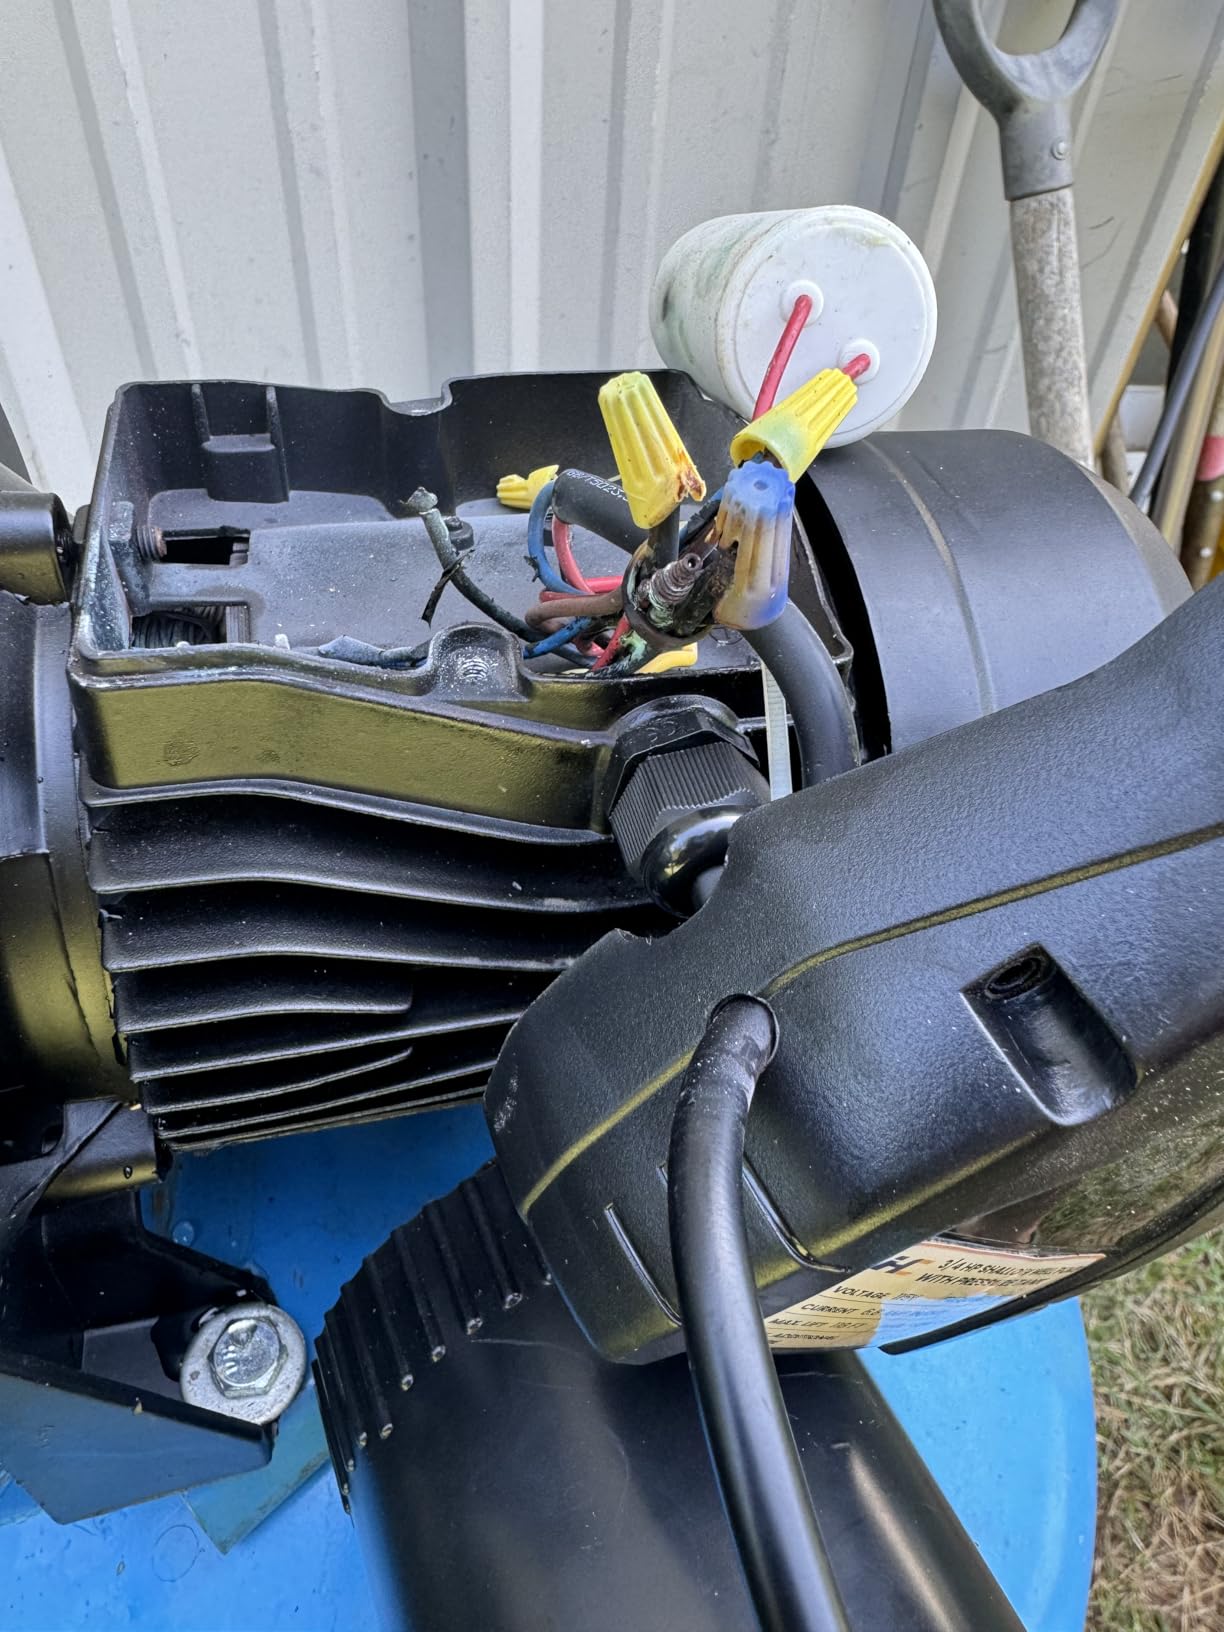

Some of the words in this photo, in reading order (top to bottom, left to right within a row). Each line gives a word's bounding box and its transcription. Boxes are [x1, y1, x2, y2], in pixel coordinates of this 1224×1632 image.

[915, 1272, 957, 1285] WITH
[833, 1285, 891, 1300] VOLTAGE
[801, 1302, 858, 1315] CURRENT
